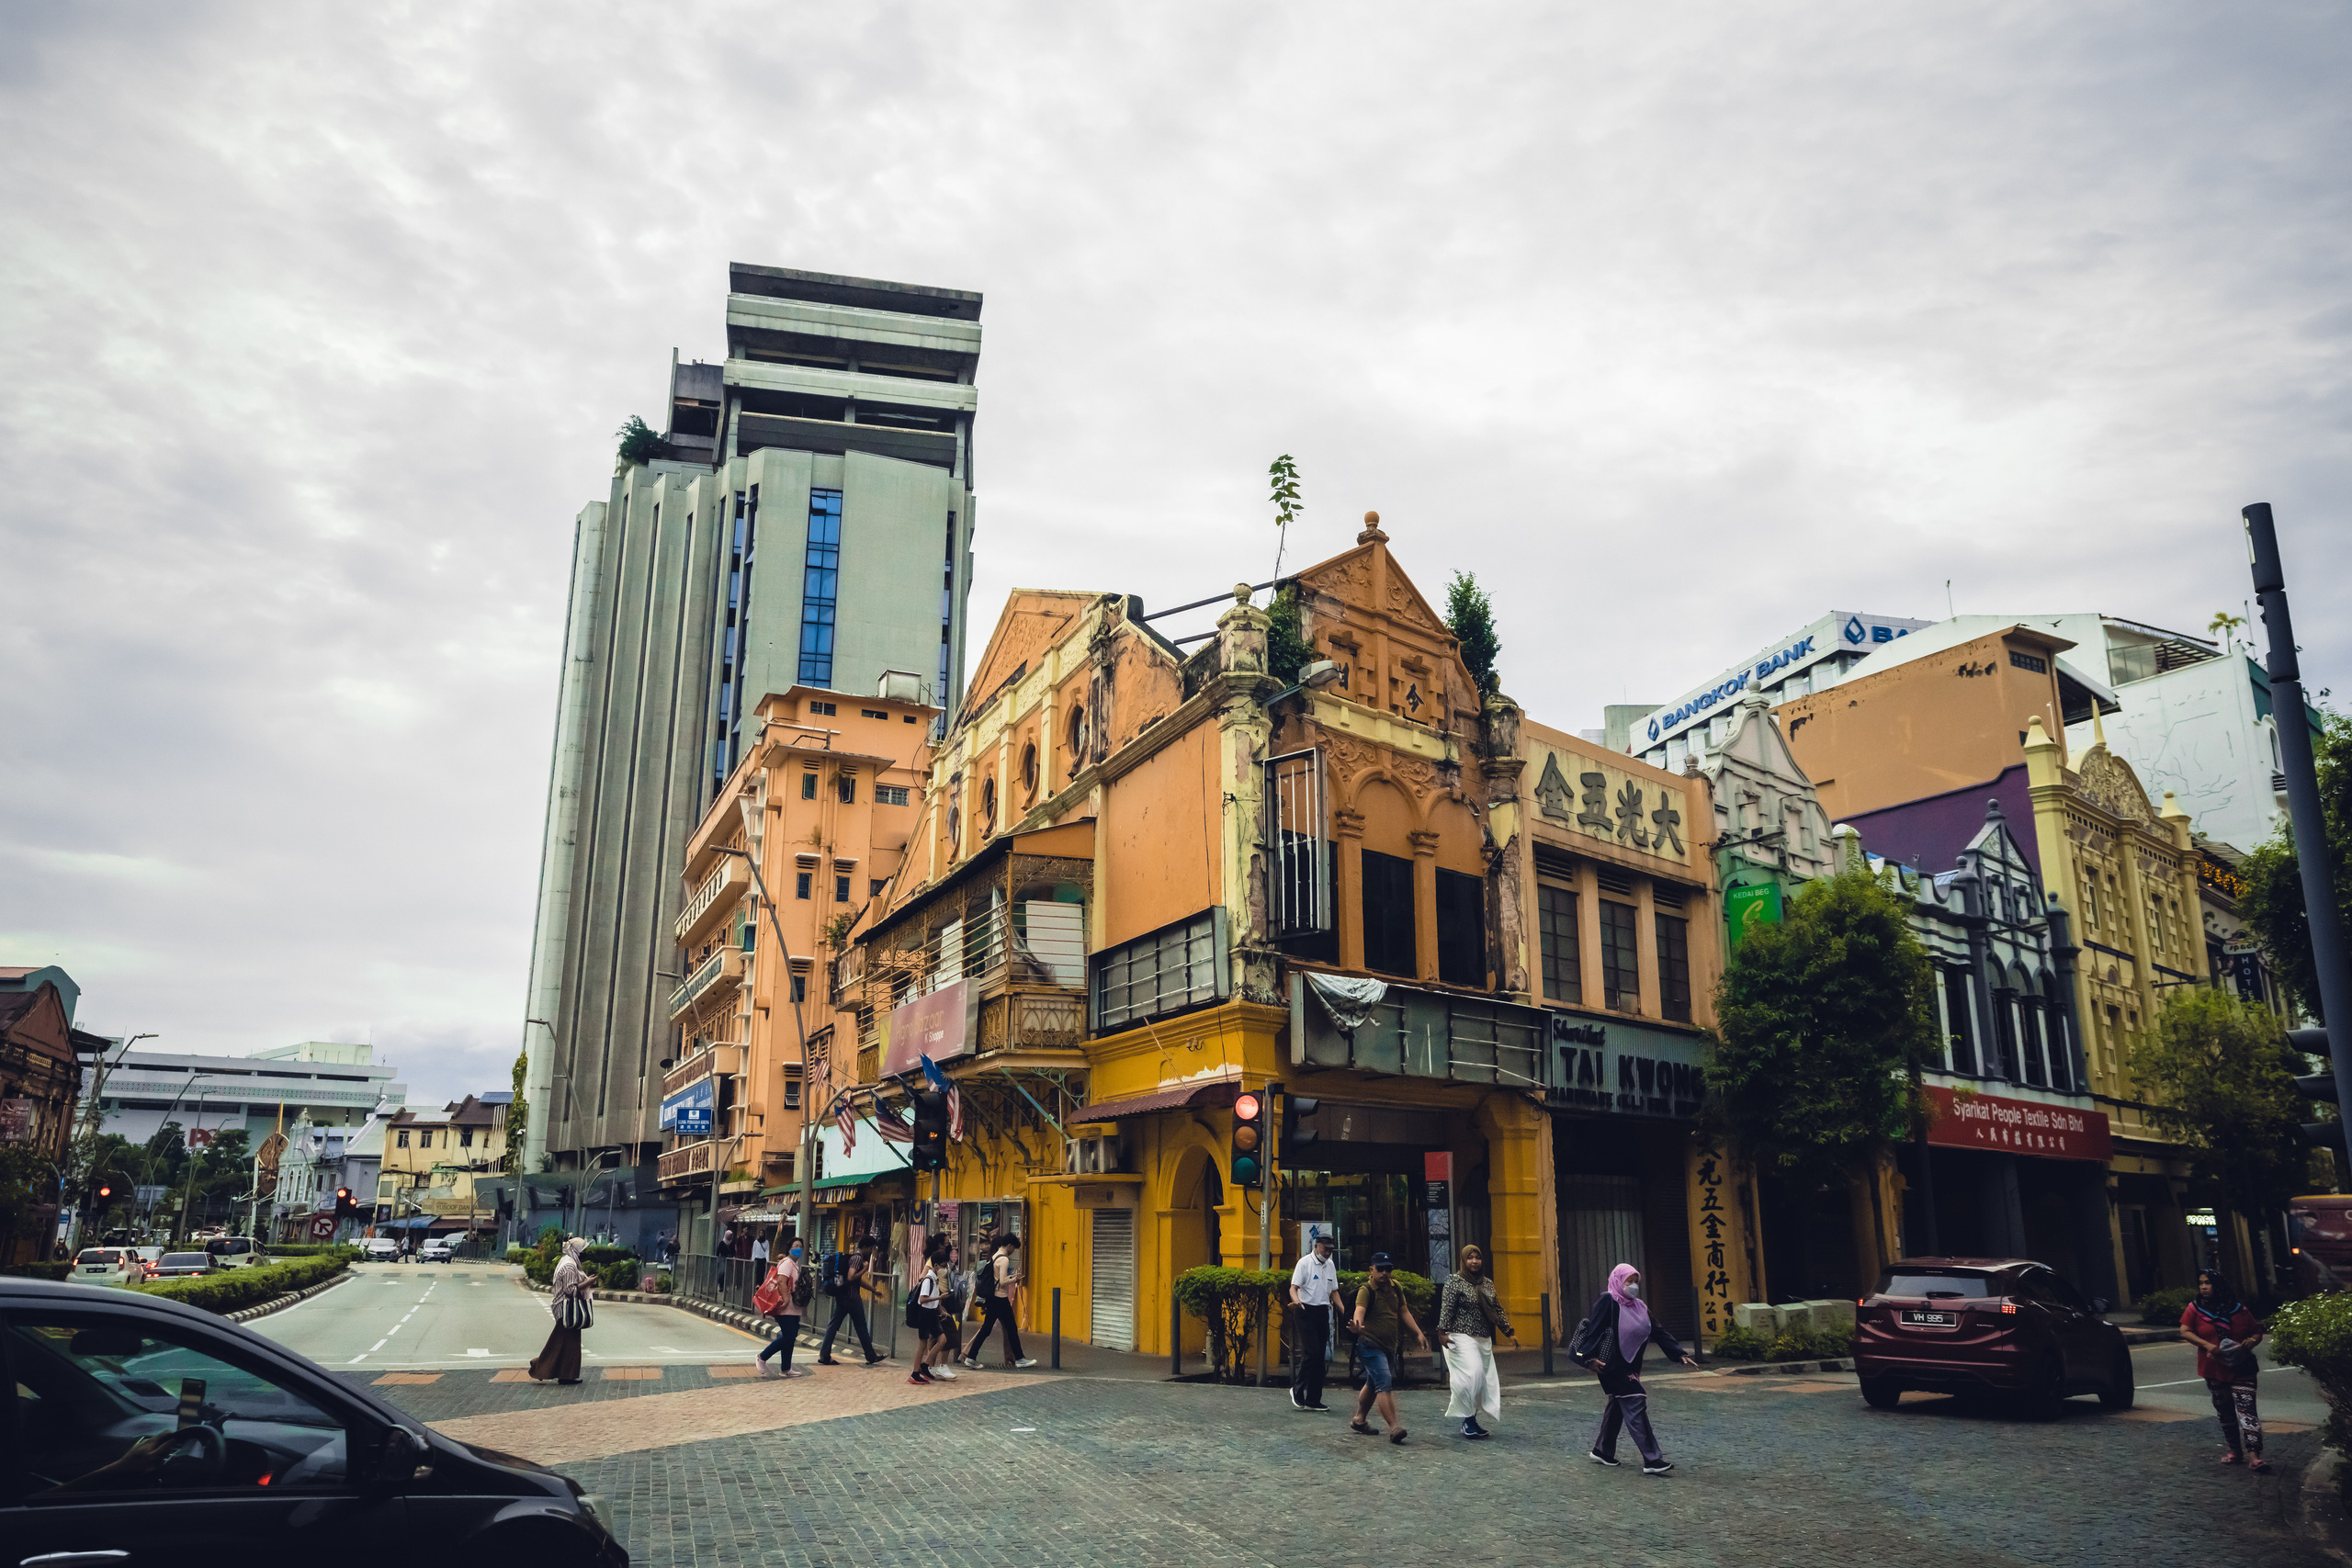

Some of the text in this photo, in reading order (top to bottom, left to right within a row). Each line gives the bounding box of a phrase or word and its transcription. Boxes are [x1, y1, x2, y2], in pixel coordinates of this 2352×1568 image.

[1662, 635, 1815, 730] BANGKOK BANK
[1733, 887, 1770, 899] KEDAI BEG
[2241, 956, 2254, 997] HOTE
[1559, 1046, 1603, 1086] TAI
[1953, 1098, 2085, 1133] Syarikat People Textile Sdn Bhd
[1705, 1302, 1716, 1333] 公司
[1913, 1313, 1925, 1321] VH
